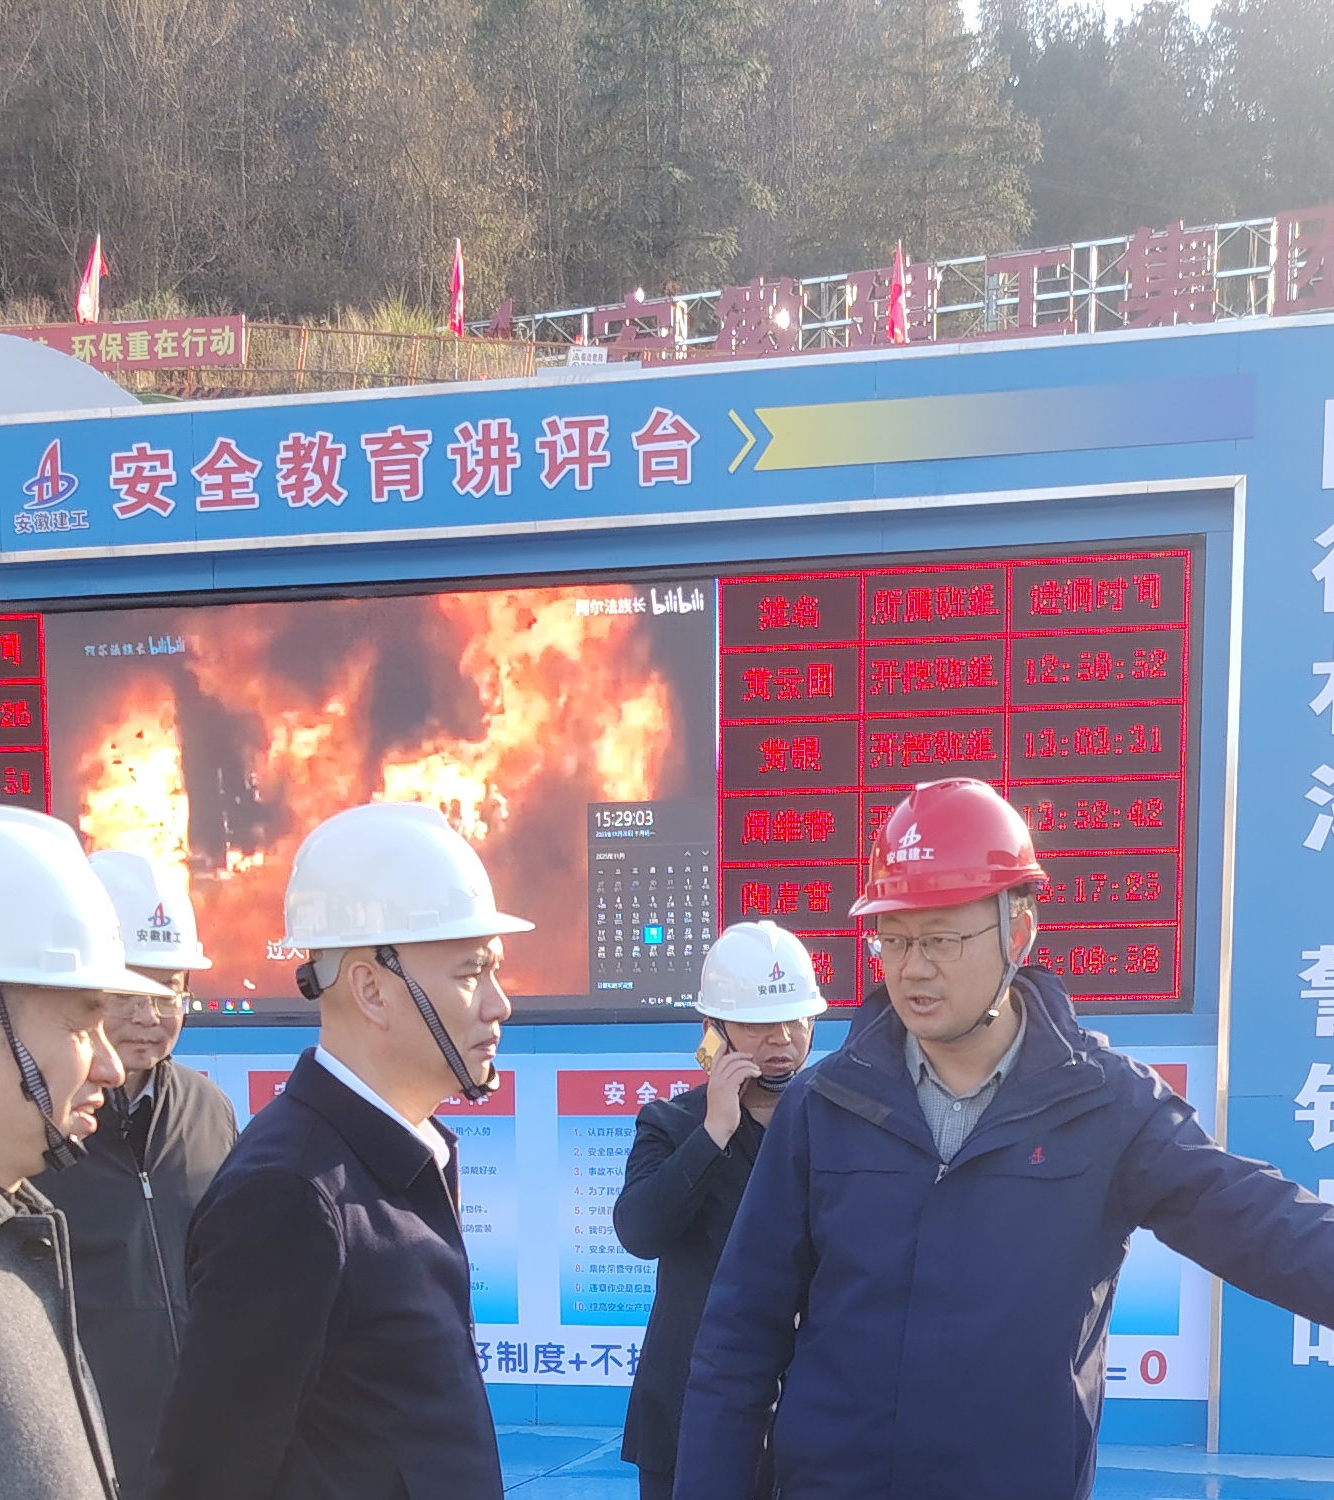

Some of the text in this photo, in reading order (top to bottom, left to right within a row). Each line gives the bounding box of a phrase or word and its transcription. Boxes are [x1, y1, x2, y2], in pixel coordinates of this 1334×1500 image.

[71, 325, 235, 364] 环保重在行动
[109, 407, 701, 519] 安全教育讲评台
[14, 510, 89, 534] 安徽建工
[575, 586, 705, 616] 阿尔法族长 bilibili
[758, 595, 820, 629] 姓名
[595, 810, 654, 827] 15:29:03
[886, 847, 935, 865] 安徽建工
[137, 928, 182, 944] 安徽建工
[757, 983, 796, 995] 安徽建工
[1139, 1350, 1167, 1384] 0
